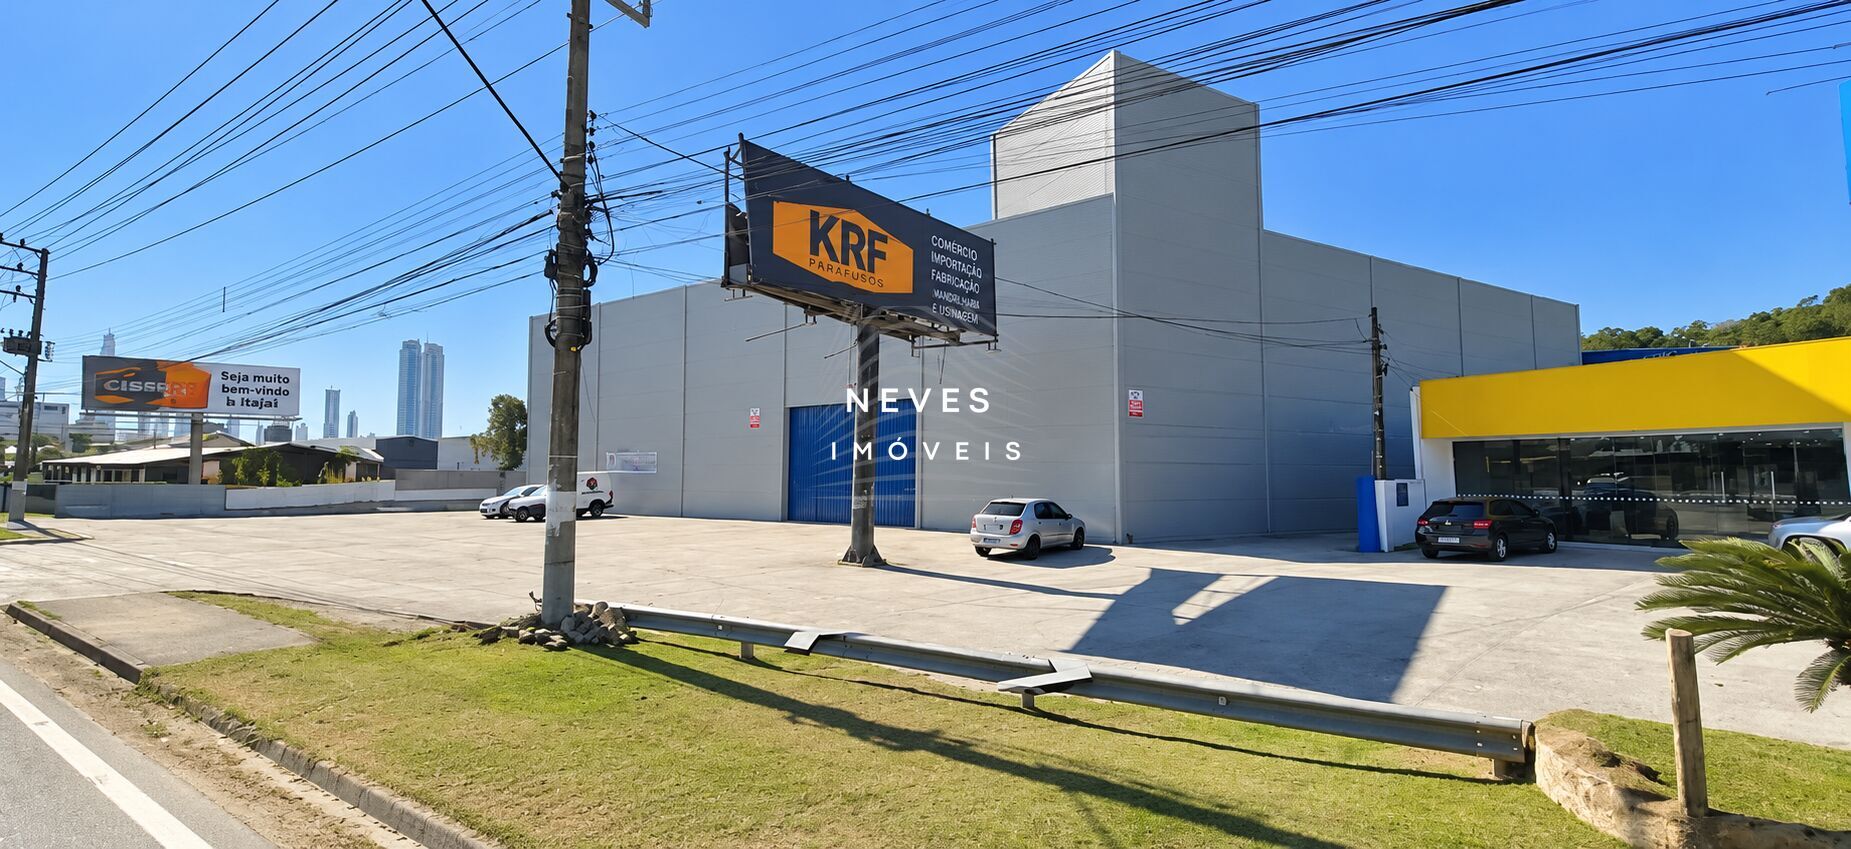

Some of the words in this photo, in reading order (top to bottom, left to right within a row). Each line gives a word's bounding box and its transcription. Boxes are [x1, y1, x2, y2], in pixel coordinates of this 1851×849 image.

[809, 209, 888, 274] KRF
[931, 235, 978, 261] COMÉRCIO
[809, 257, 885, 288] PARAFUSOS
[931, 250, 982, 279] IMPORTAÇÃO
[931, 268, 980, 294] FABRICAÇÃO
[932, 302, 938, 314] E
[221, 371, 249, 384] Seja
[253, 373, 290, 384] muito
[222, 384, 290, 397] bem-vindo
[240, 396, 279, 410] Itajaí
